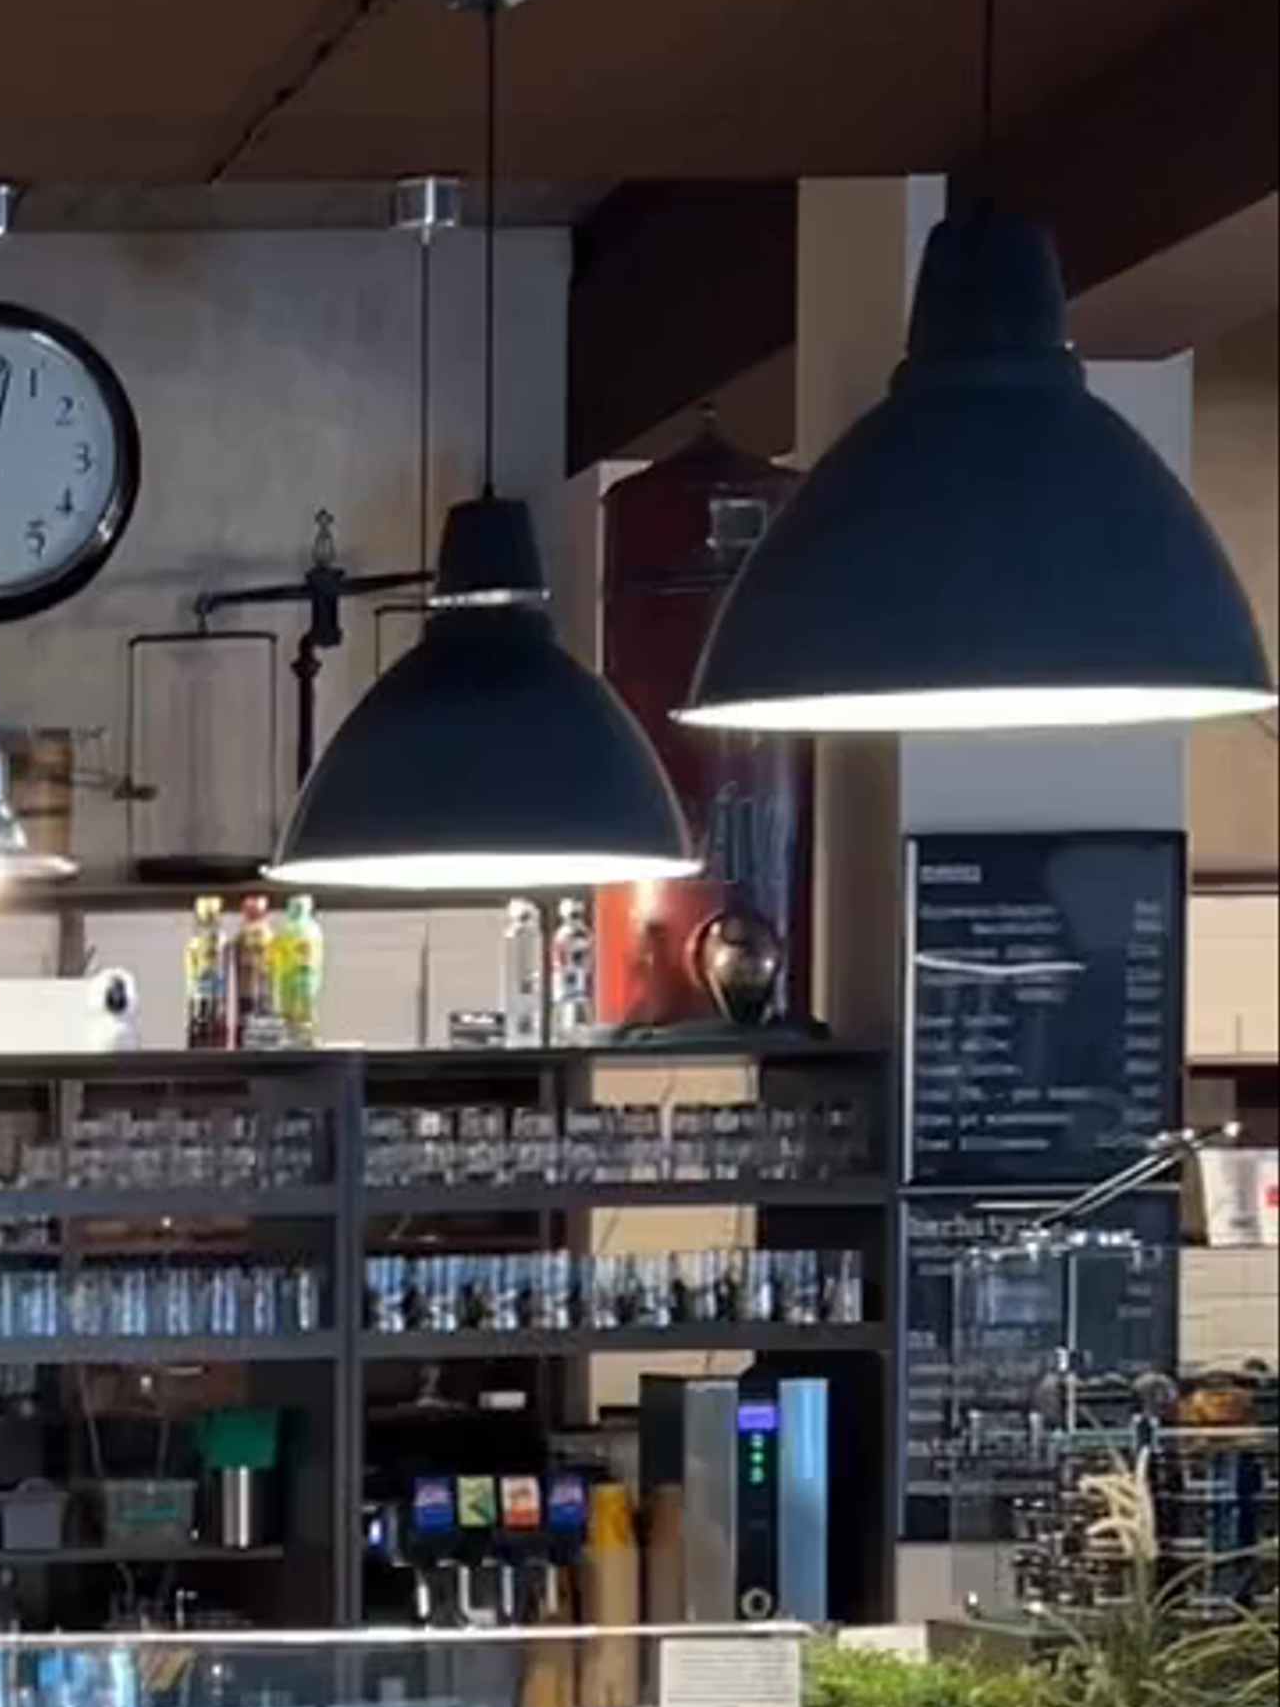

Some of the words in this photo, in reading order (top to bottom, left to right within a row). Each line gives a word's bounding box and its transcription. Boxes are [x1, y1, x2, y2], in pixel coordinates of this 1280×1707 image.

[28, 367, 40, 398] 1
[54, 396, 77, 427] 2
[73, 443, 93, 474] 3
[54, 487, 76, 516] 4
[25, 519, 47, 557] 5
